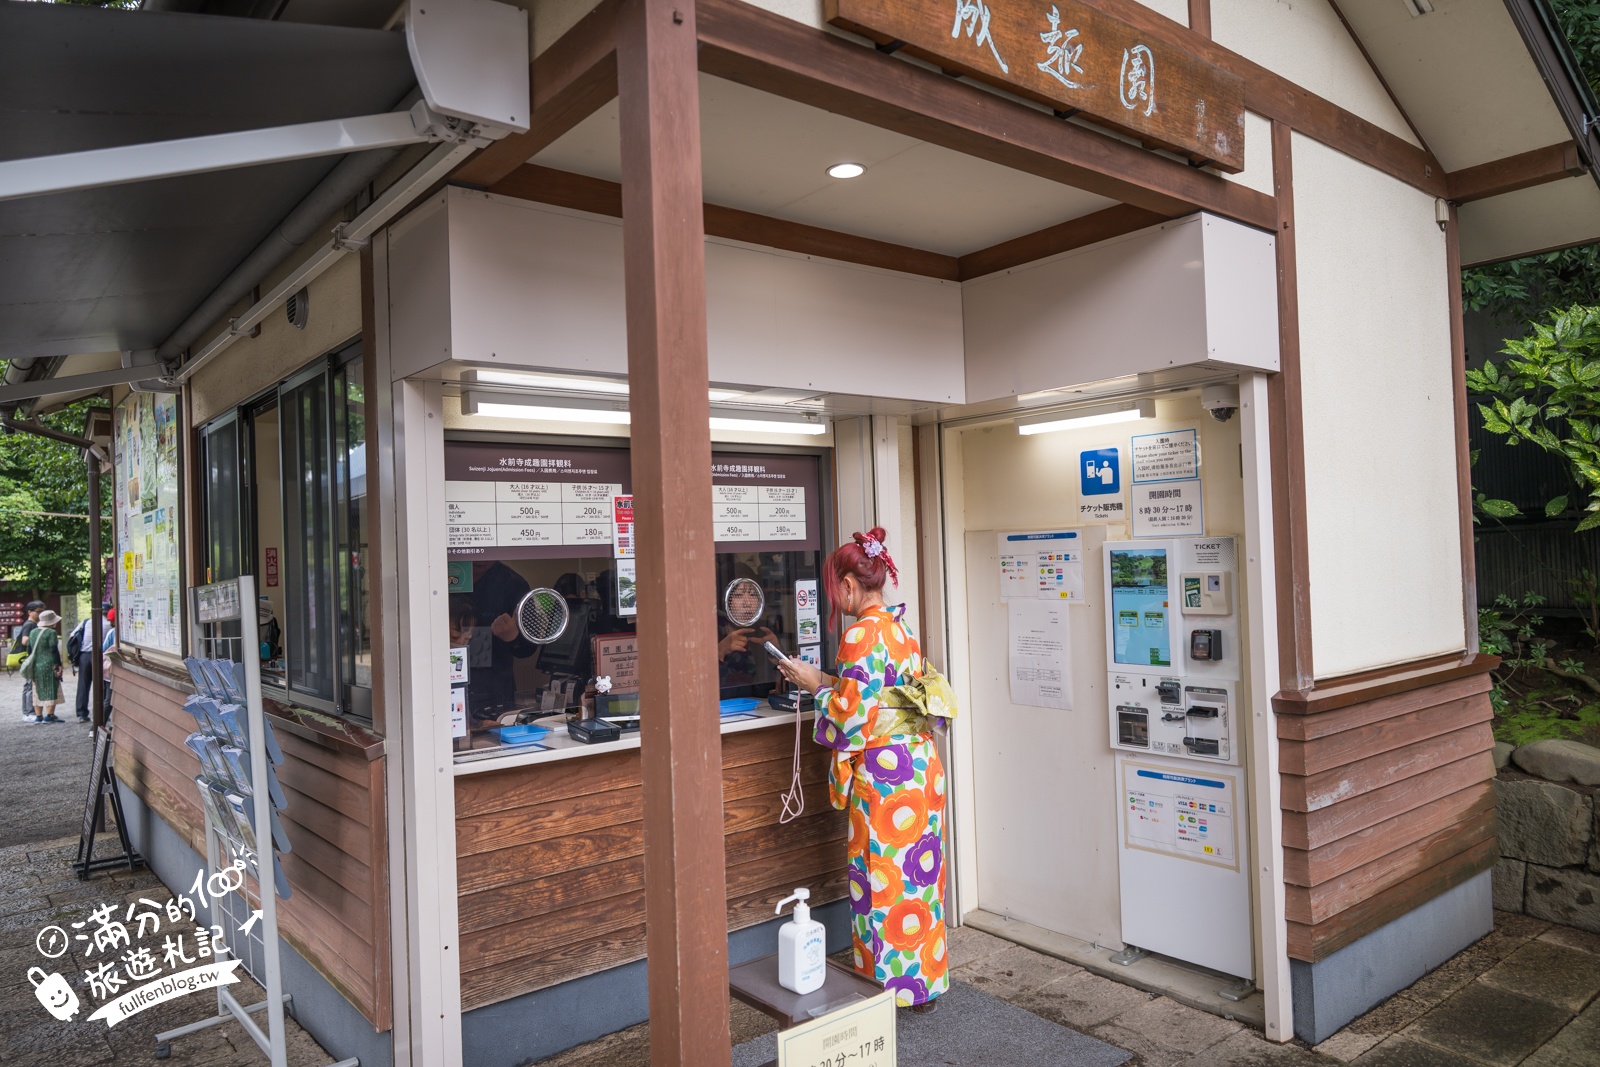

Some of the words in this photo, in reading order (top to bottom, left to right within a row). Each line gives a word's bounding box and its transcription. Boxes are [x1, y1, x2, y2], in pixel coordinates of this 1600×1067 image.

[520, 507, 540, 515] 500円
[584, 507, 603, 515] 200円
[1080, 502, 1124, 512] チケット販売機
[520, 529, 541, 537] 450円
[585, 528, 603, 536] 180円
[822, 1025, 858, 1051] 開園時間
